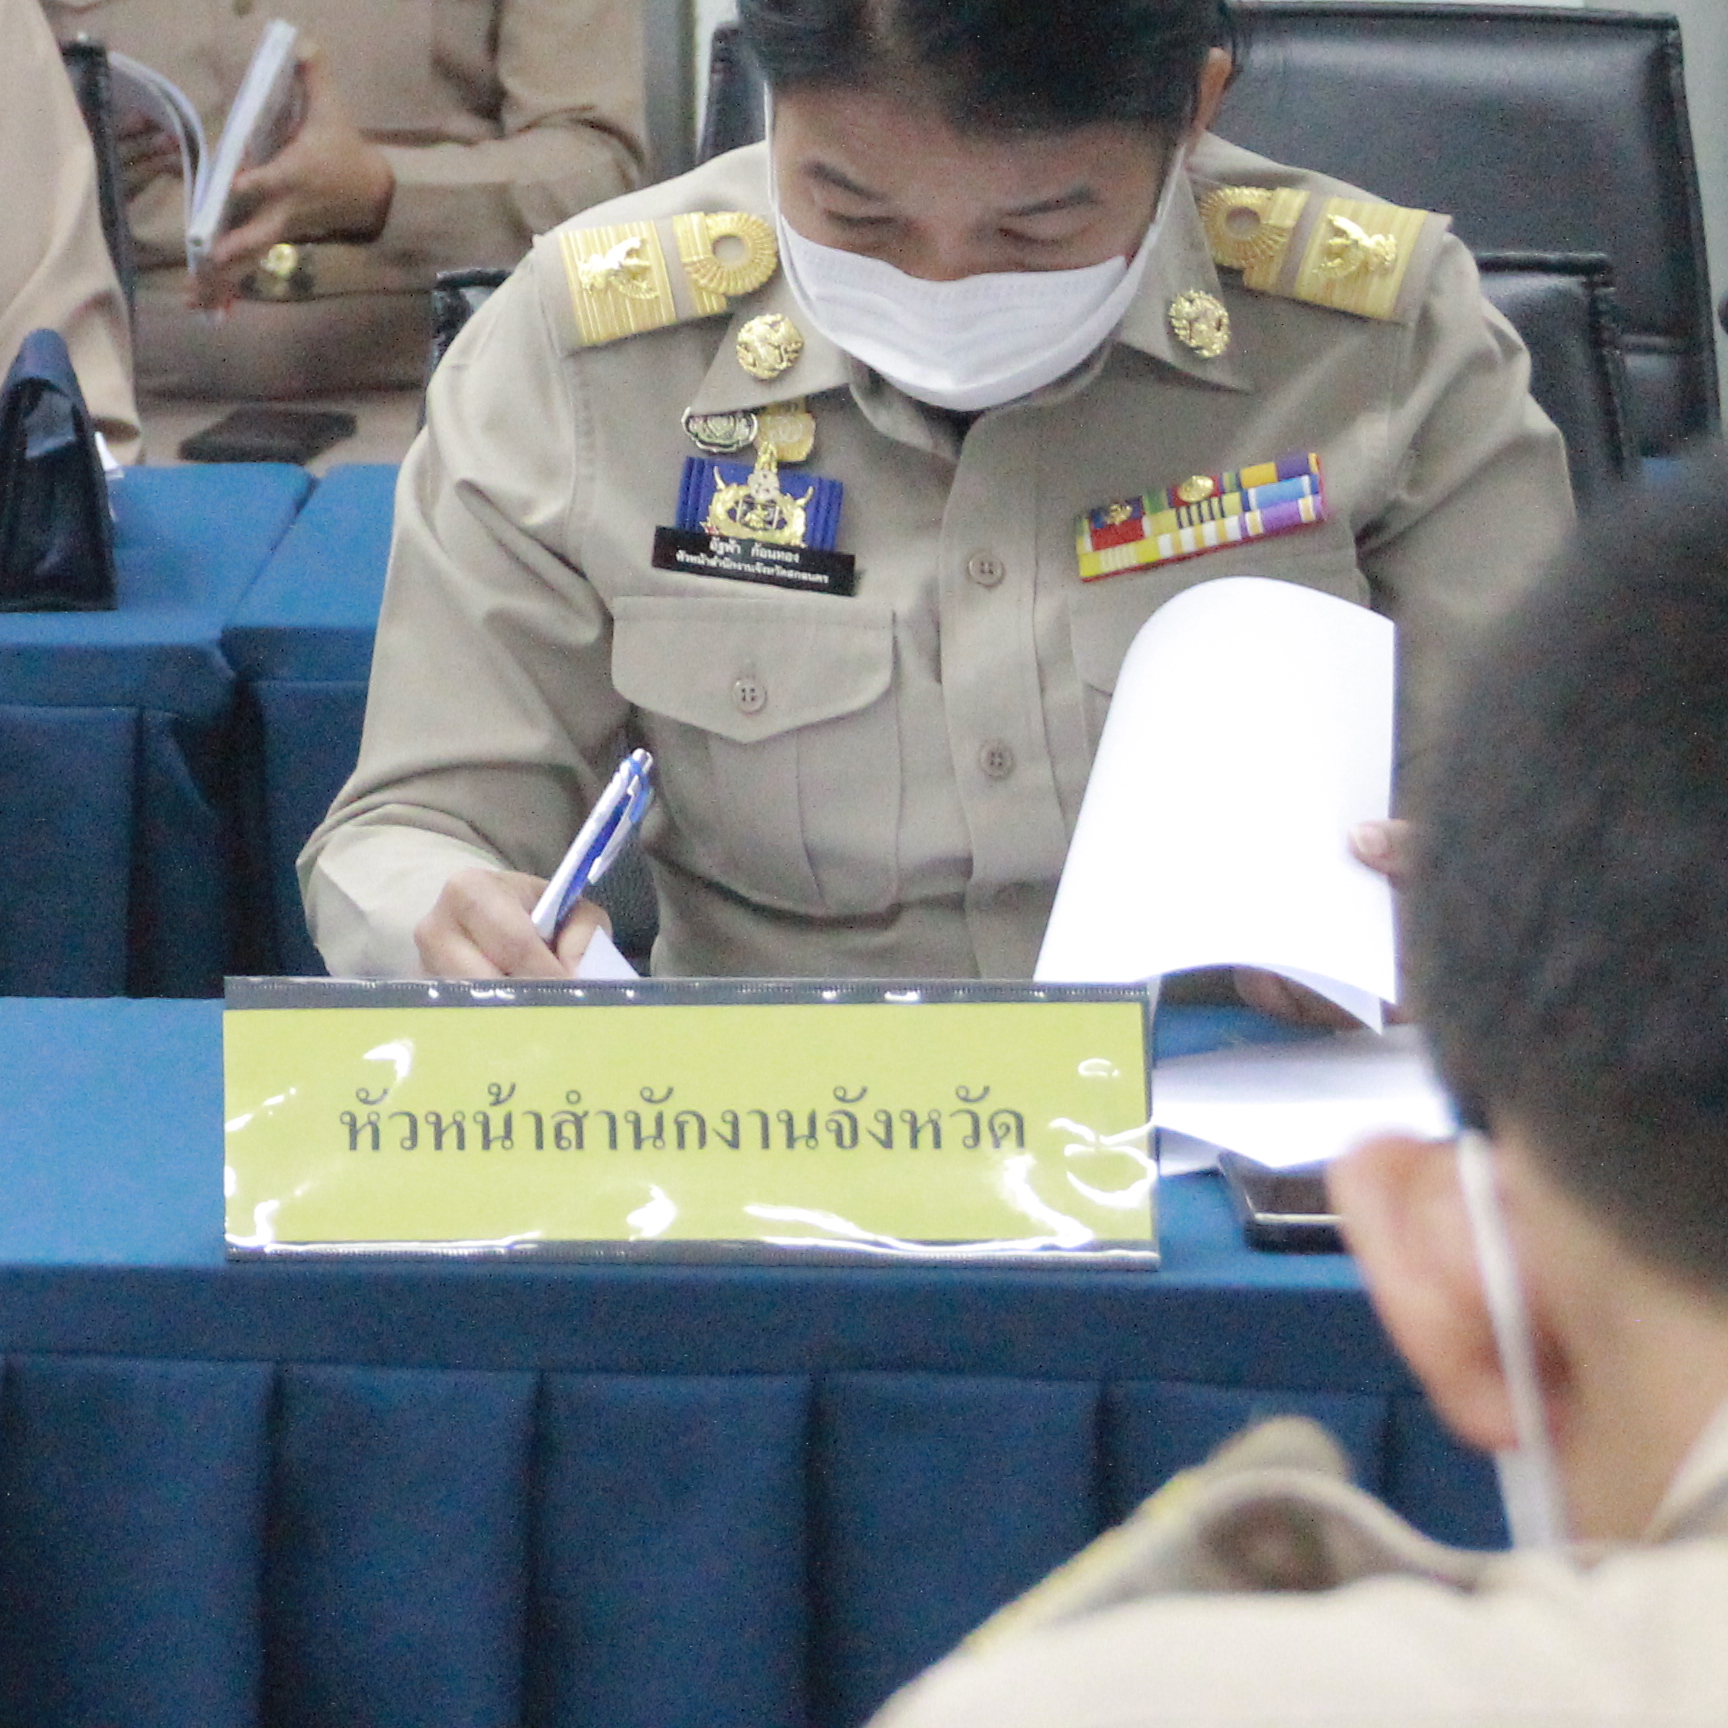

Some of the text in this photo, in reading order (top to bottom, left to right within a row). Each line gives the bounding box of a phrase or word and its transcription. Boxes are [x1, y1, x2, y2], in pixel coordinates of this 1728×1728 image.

[339, 1082, 1026, 1152] หัวหน้าสำนักงานจังหวัด
